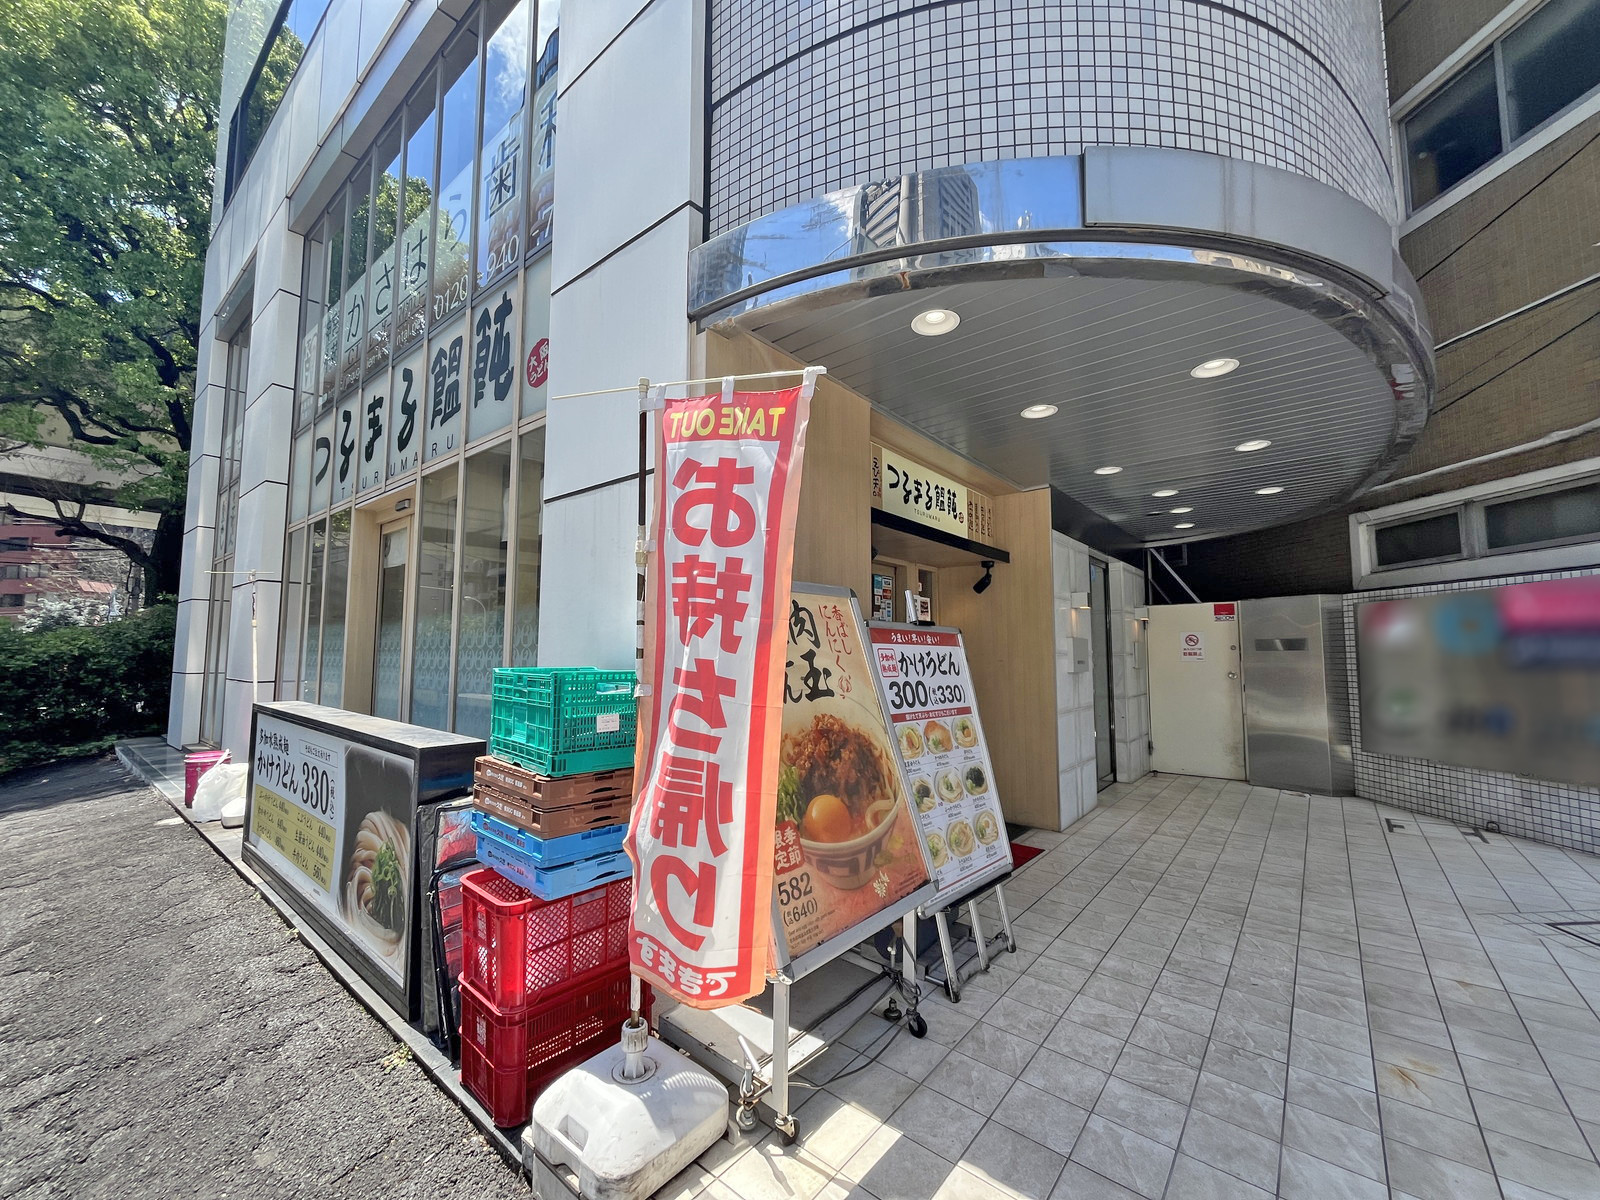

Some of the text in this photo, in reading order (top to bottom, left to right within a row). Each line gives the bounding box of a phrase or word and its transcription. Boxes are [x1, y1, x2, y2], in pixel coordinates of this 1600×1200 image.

[315, 291, 514, 488] つるまる饂飩
[887, 463, 958, 521] つるまる饂飩
[914, 508, 941, 523] TSURUMARU
[818, 604, 846, 673] にんにく
[832, 604, 852, 655] 香ばし
[898, 651, 960, 678] かけうどん
[888, 680, 928, 709] 300
[257, 750, 299, 794] かけうどん
[301, 762, 329, 815] 330
[777, 871, 813, 906] 582
